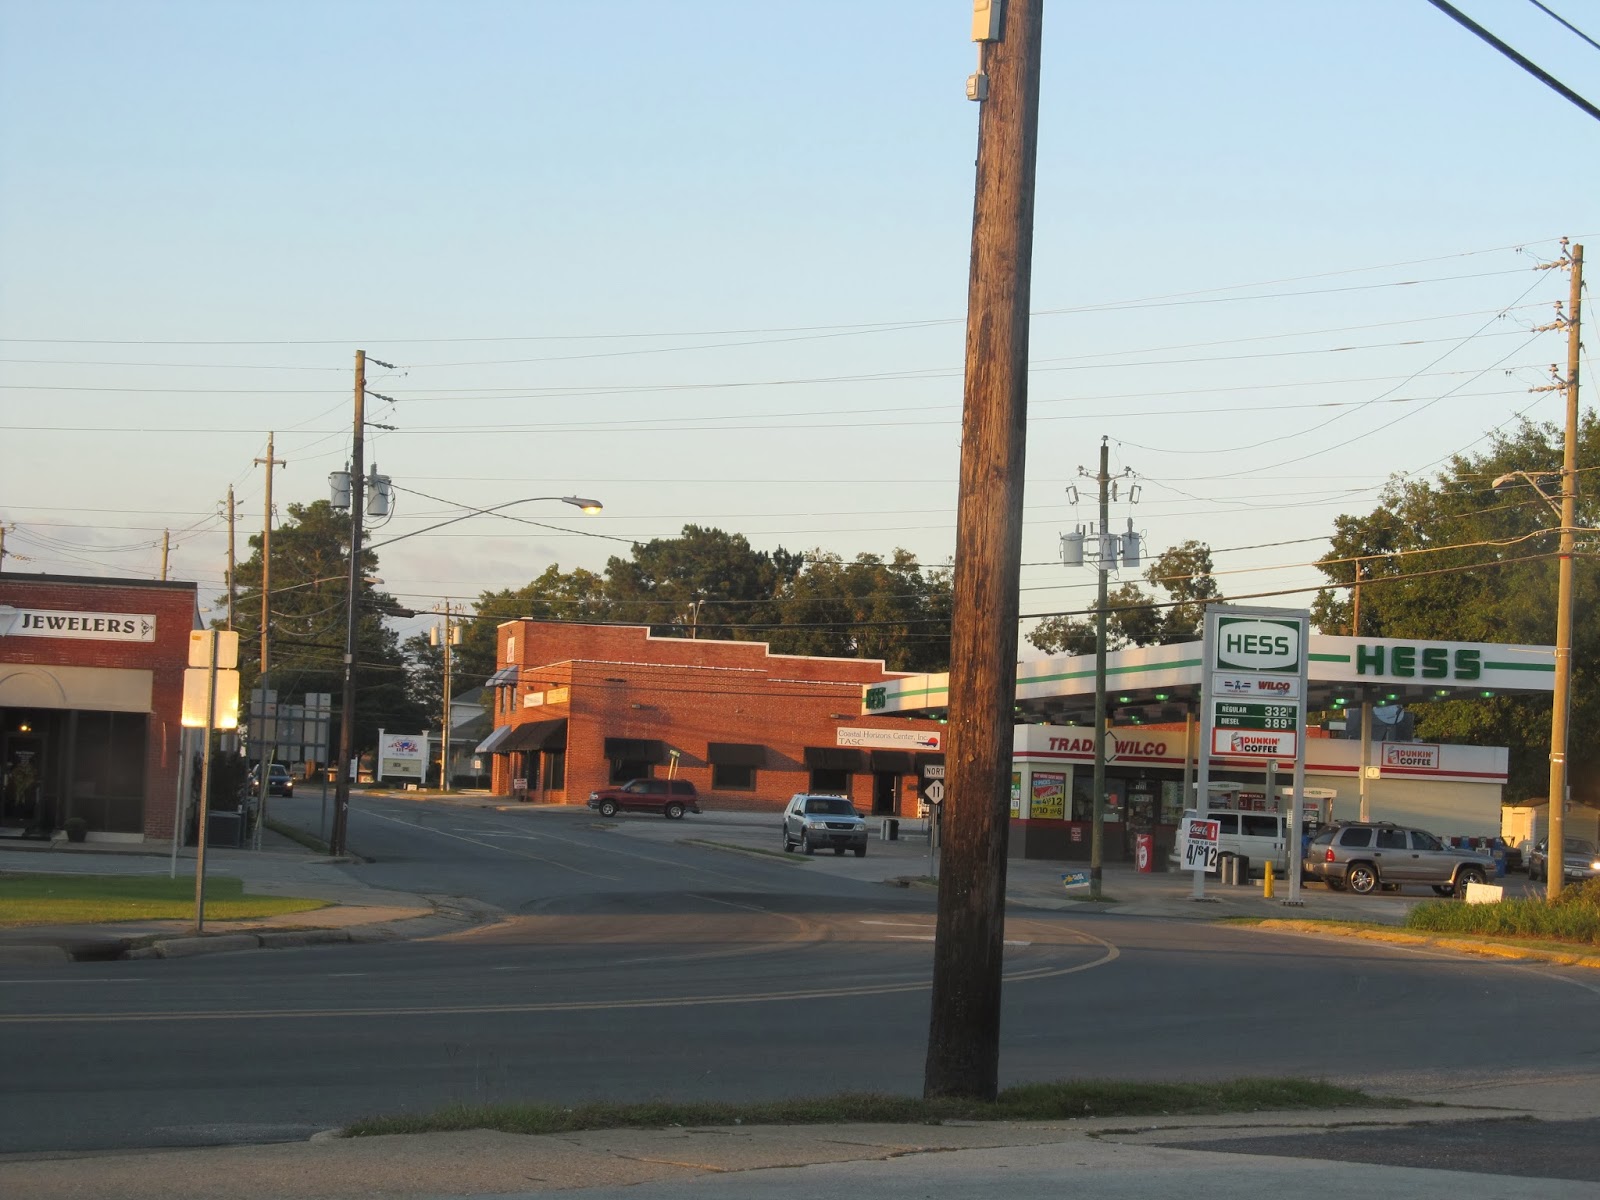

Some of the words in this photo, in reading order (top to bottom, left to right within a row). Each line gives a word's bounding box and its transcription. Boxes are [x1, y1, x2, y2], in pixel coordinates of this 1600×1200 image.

[21, 613, 136, 634] JEWELERS
[1226, 633, 1289, 656] HESS
[1356, 644, 1481, 680] HESS
[1258, 680, 1290, 691] WILCO
[1221, 705, 1247, 713] REGULAR
[1264, 706, 1287, 717] 332
[1220, 717, 1240, 725] DIESEL
[1264, 718, 1288, 729] 389
[838, 729, 862, 738] Coastal
[863, 730, 891, 739] Horizons
[838, 738, 864, 746] TASC
[1244, 736, 1280, 745] DUNKIN'
[1114, 740, 1167, 756] WILCO
[1244, 744, 1278, 753] COFFEE
[1400, 749, 1434, 758] DUNKIN'
[1400, 757, 1431, 766] COFFEE
[932, 786, 940, 798] 11
